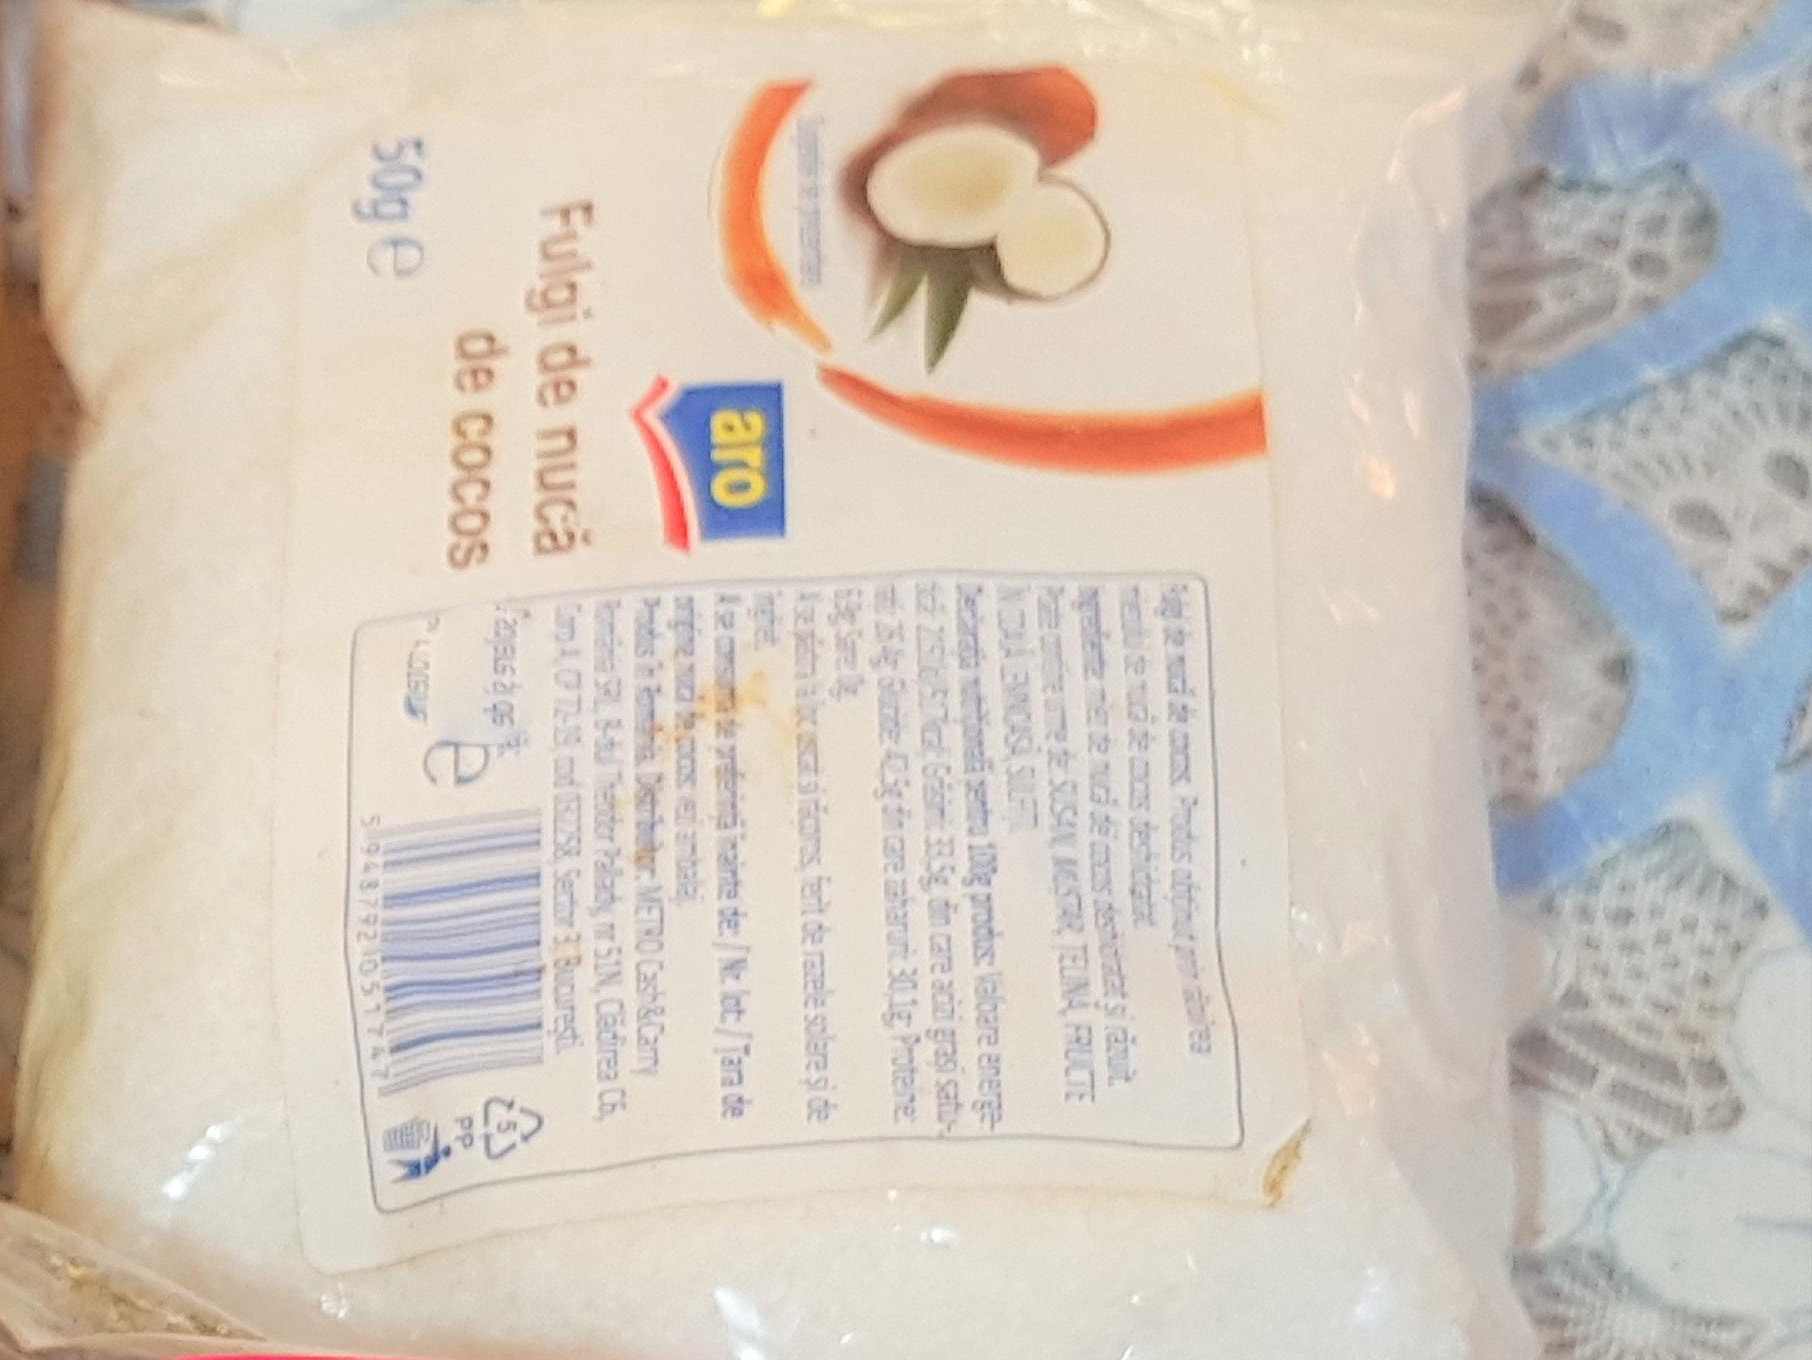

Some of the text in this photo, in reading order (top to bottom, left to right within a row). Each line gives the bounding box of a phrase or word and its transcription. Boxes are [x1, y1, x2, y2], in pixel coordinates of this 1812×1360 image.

[352, 137, 428, 222] 50g
[524, 198, 595, 556] Fulgi de nucă
[448, 329, 510, 570] de cocos
[710, 408, 769, 507] aro
[802, 922, 831, 945] de
[930, 933, 951, 974] care
[548, 954, 583, 1054] București.
[630, 885, 665, 1077] METRO Cash&Carry
[802, 951, 834, 1008] razele
[975, 973, 1003, 1046] Valoare
[594, 999, 626, 1082] Clădirea
[804, 1014, 836, 1072] solare
[1064, 1024, 1095, 1103] FRUCTE
[497, 1120, 517, 1135] 5
[722, 1095, 753, 1118] de
[806, 1097, 837, 1123] de
[972, 1052, 1003, 1132] energe-
[454, 1116, 474, 1149] PP
